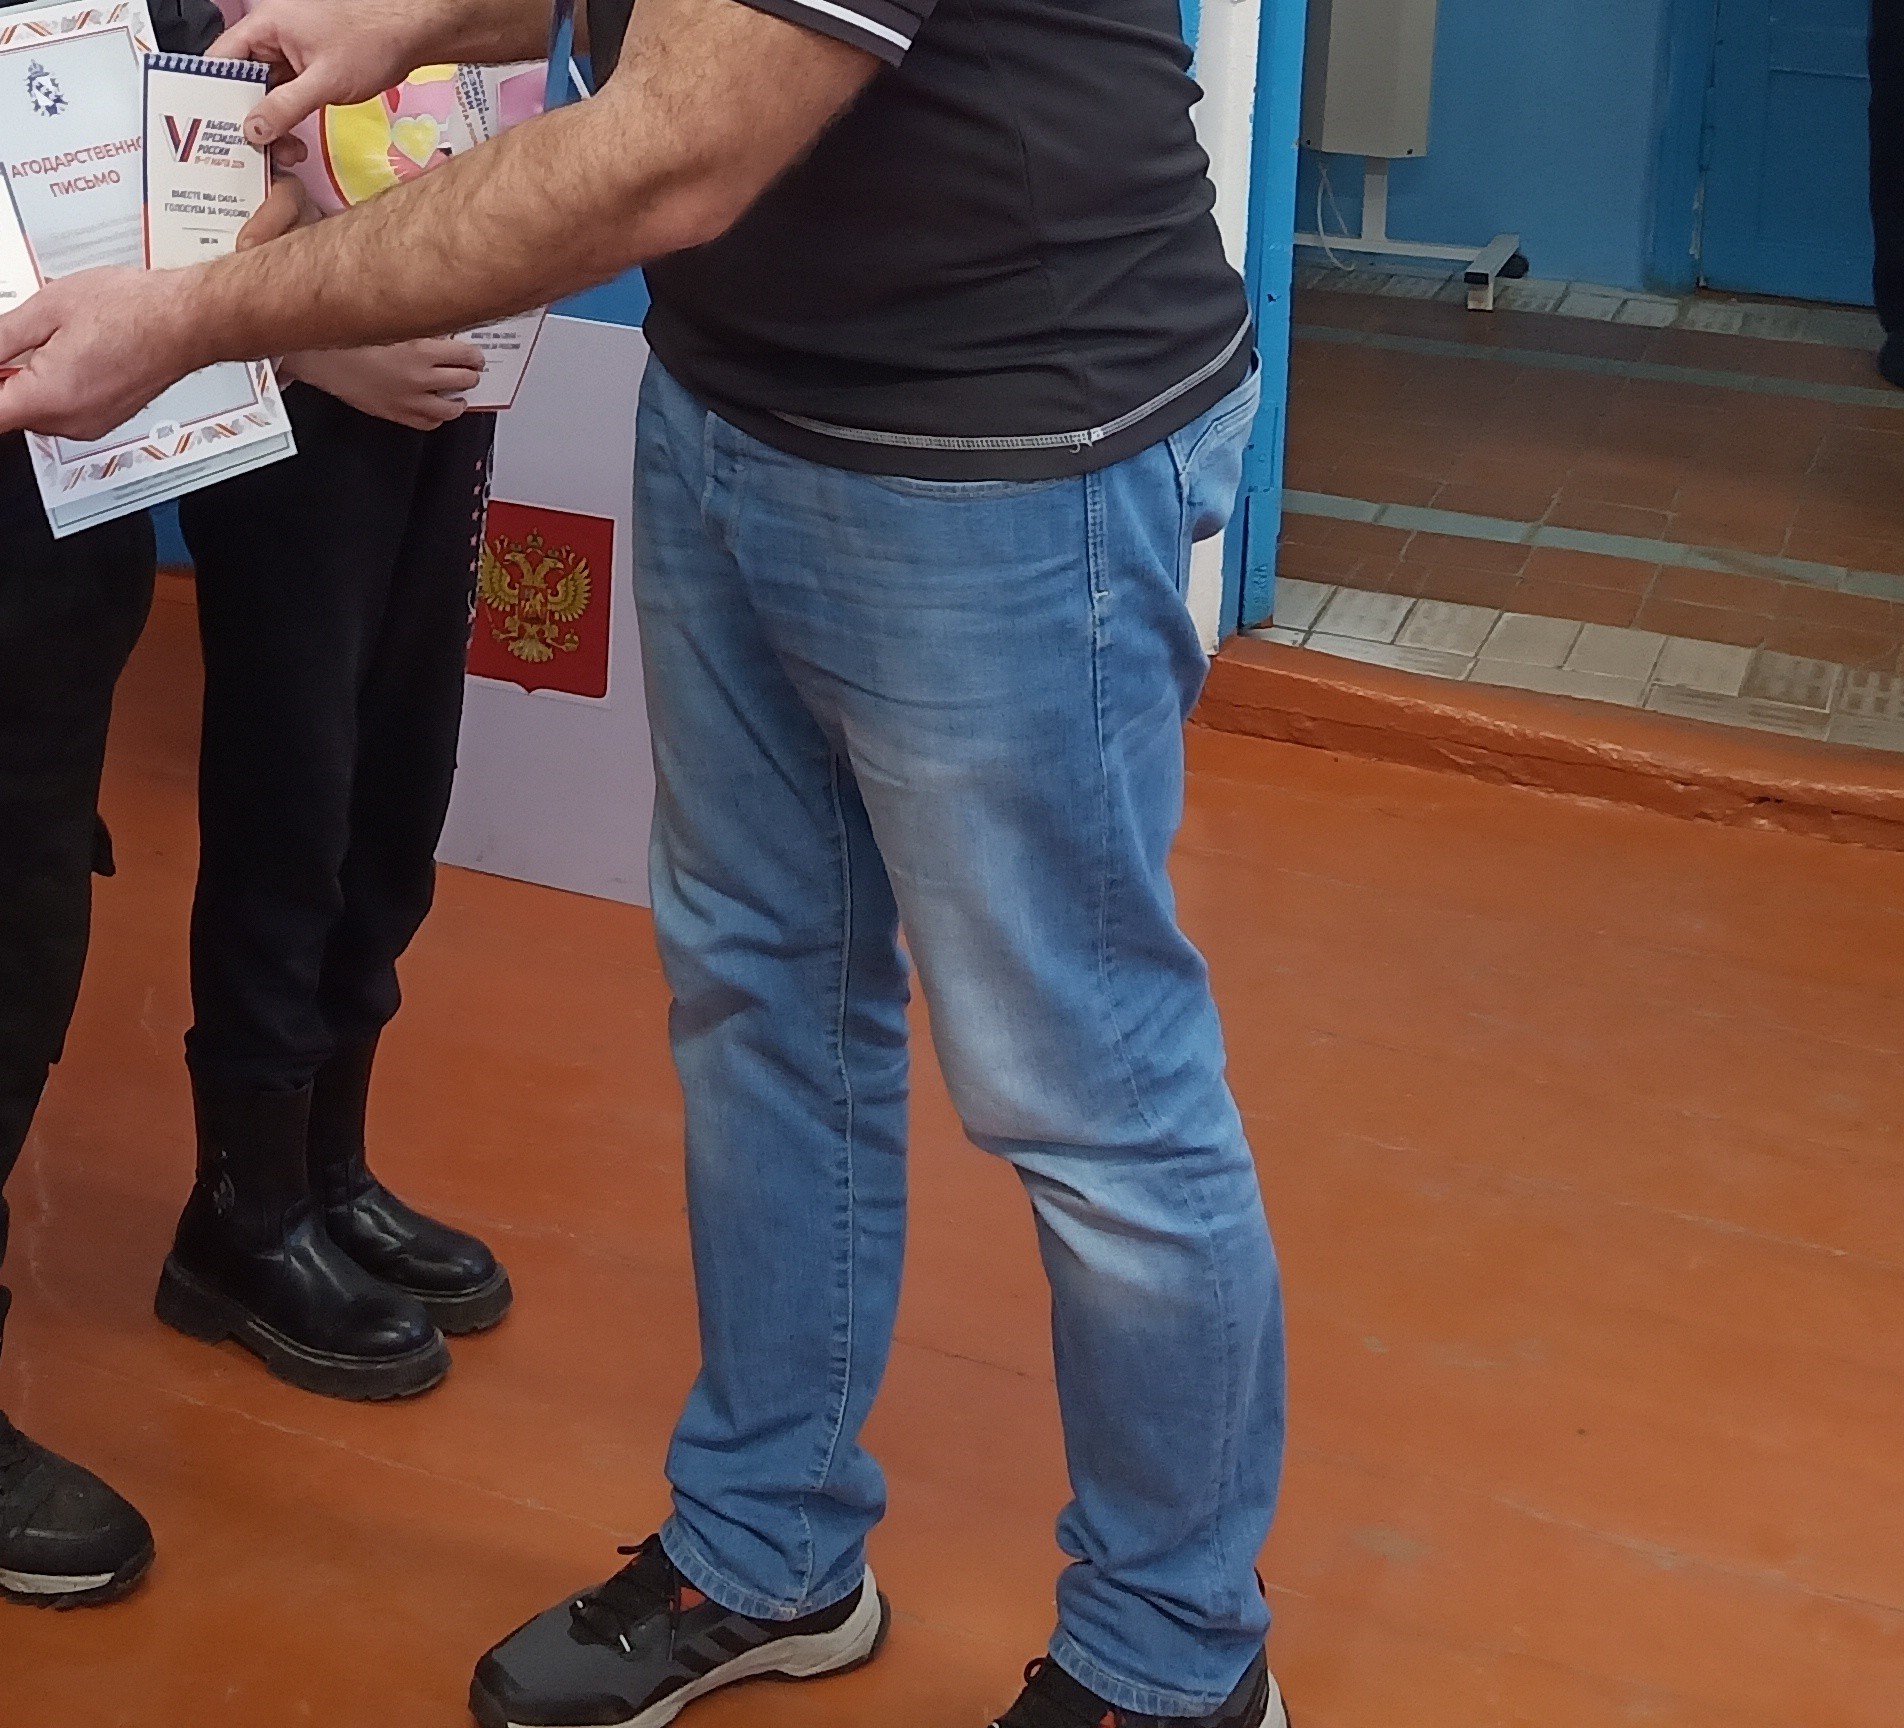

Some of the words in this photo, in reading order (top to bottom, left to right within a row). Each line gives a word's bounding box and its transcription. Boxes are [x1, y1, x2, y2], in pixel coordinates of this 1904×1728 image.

[201, 132, 248, 145] ПРЕЗИДЕНТ
[197, 144, 230, 155] РОССИИ
[49, 169, 121, 198] ПИСЬМО
